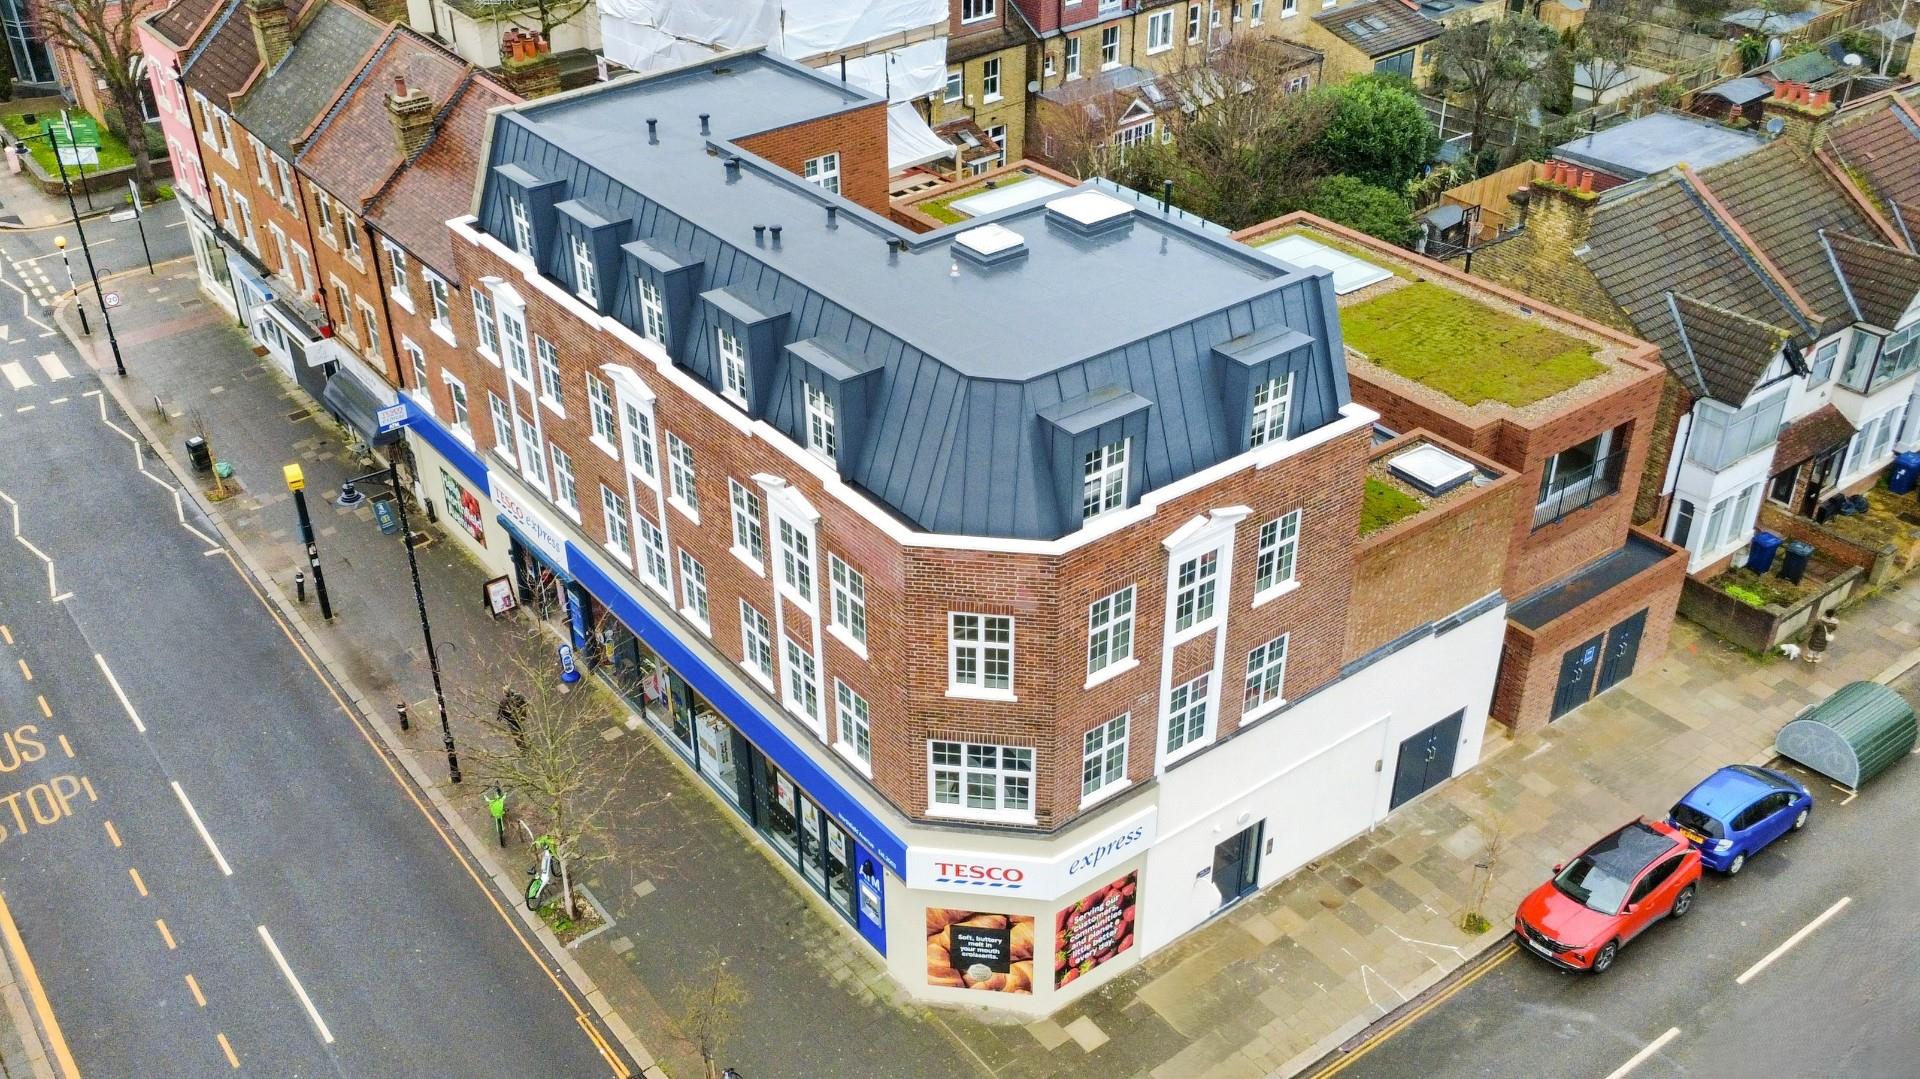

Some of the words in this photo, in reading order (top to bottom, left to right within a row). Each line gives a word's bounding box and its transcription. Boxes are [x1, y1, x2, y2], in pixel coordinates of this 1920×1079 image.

[494, 485, 524, 519] TESCO
[526, 516, 560, 553] express
[0, 775, 81, 844] TOP
[934, 862, 1024, 882] TESCO
[1069, 824, 1143, 875] express
[859, 864, 880, 891] AM
[1074, 903, 1104, 925] Serving
[1106, 895, 1120, 906] our
[976, 935, 1002, 945] buttery
[1070, 909, 1122, 942] communities
[1072, 936, 1087, 950] and
[1089, 921, 1113, 942] planet
[1072, 943, 1092, 959] little
[1093, 928, 1118, 947] better
[1075, 947, 1098, 964] every
